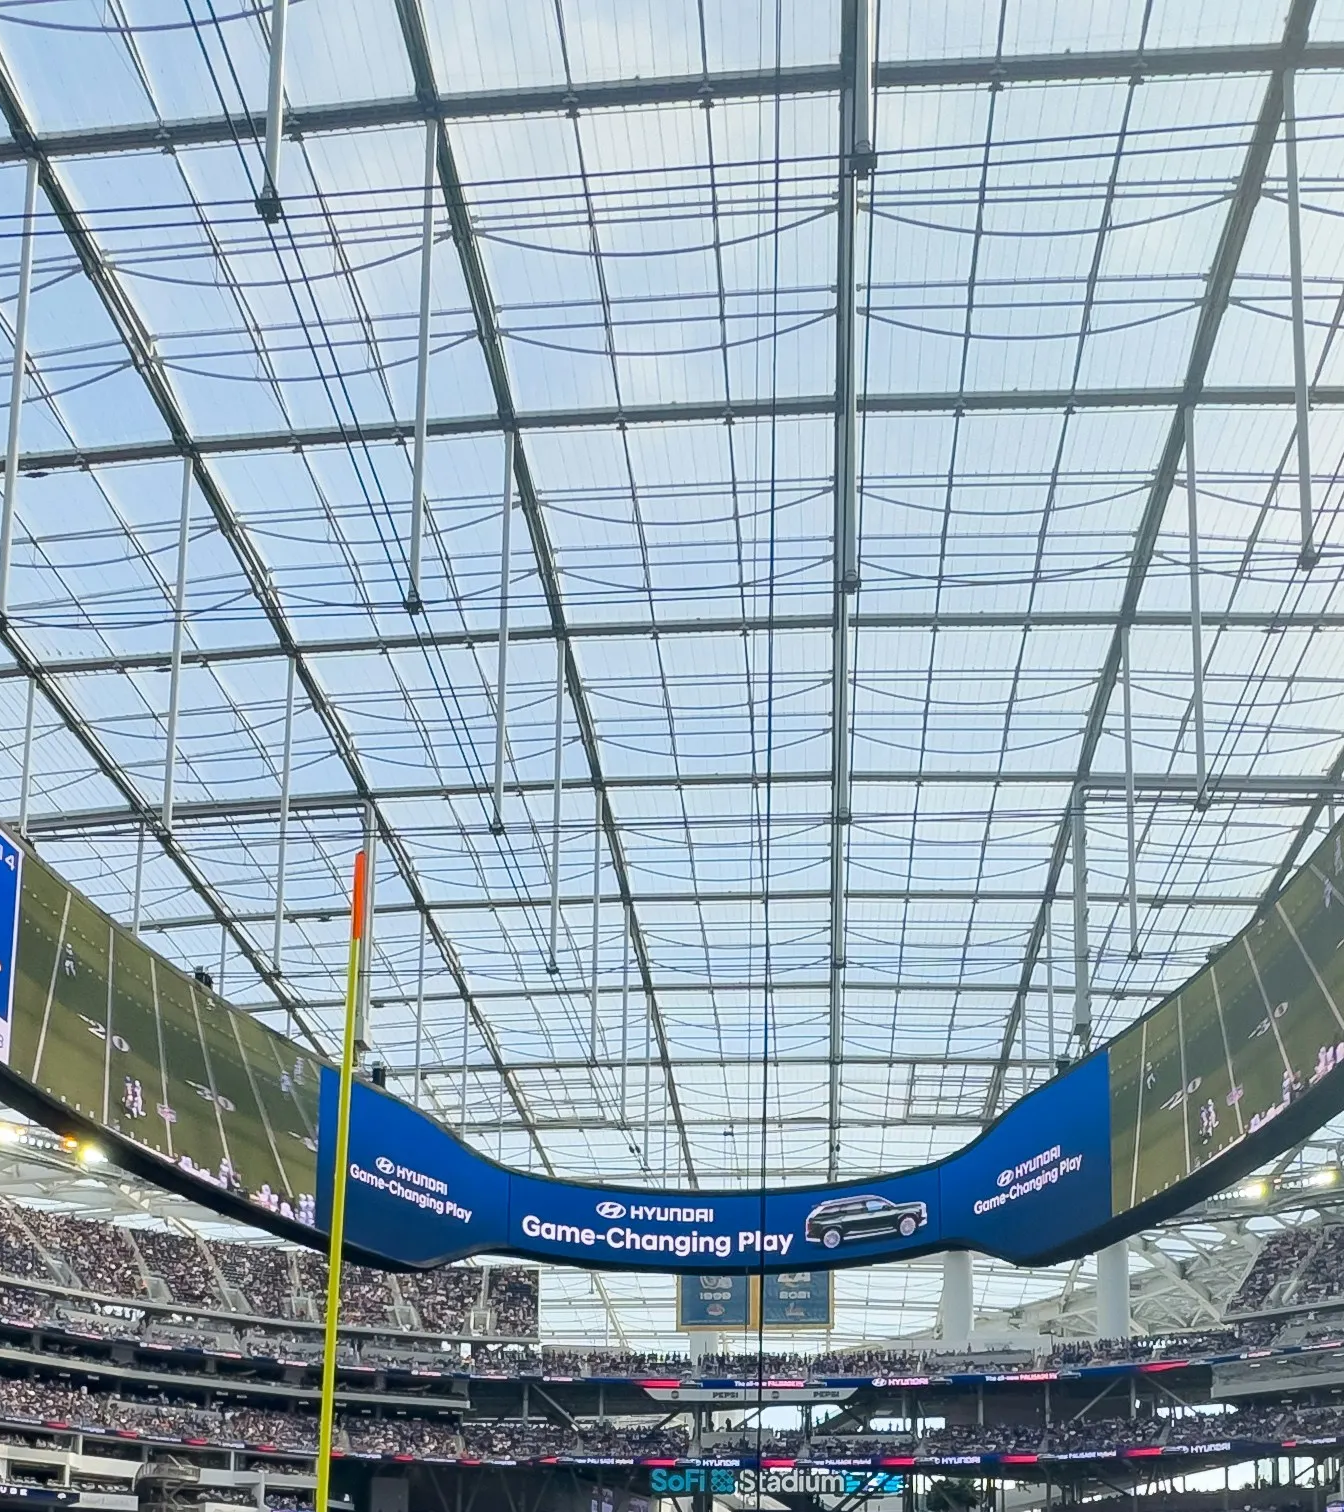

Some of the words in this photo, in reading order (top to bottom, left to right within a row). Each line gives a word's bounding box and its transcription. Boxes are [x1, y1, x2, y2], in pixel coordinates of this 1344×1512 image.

[1015, 1144, 1061, 1180] HYUNDAI
[396, 1165, 448, 1196] HYUNDAI
[974, 1170, 1058, 1215] Game-Changing
[1059, 1153, 1083, 1174] Play
[350, 1164, 444, 1215] Game-Changing
[445, 1201, 473, 1224] Play
[631, 1205, 714, 1223] HYUNDAI
[522, 1215, 731, 1258] Game-Changing
[739, 1231, 794, 1256] Play
[712, 1391, 739, 1399] PEPSI
[941, 1456, 980, 1464] HYUNDAI
[1190, 1442, 1231, 1453] HYUNDAI
[702, 1459, 740, 1467] HYUNDAI
[651, 1469, 705, 1492] SoFi
[739, 1468, 844, 1493] Stadium
